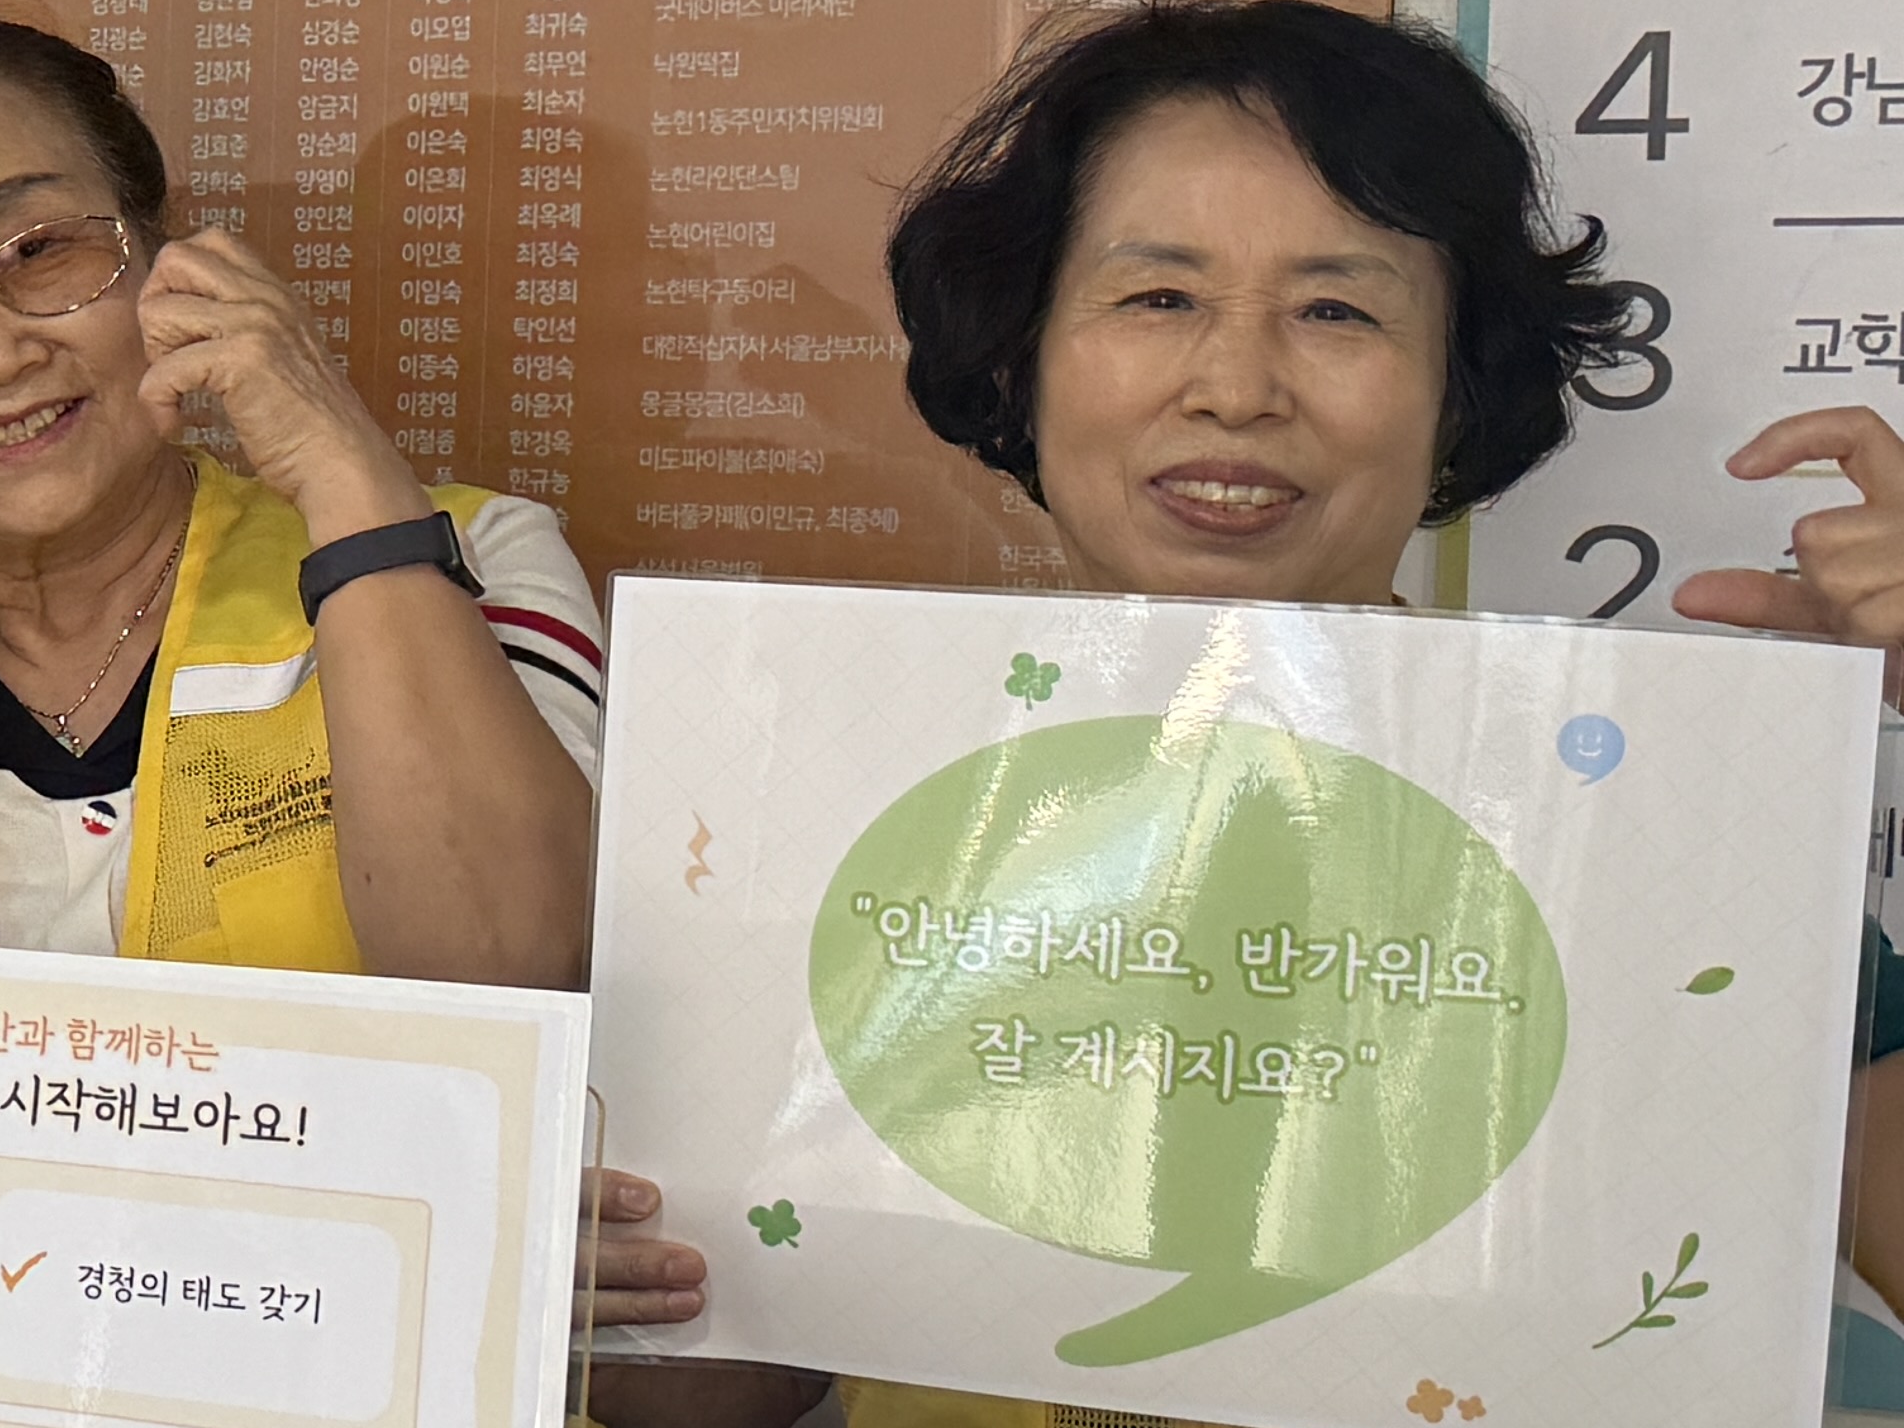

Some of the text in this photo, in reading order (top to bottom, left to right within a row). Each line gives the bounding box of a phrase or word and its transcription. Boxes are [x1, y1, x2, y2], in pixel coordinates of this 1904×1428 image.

[1575, 31, 1691, 162] 4
[647, 221, 776, 248] 논현어린이집
[855, 894, 1525, 1012] "안녕하세요, 반가워요.
[67, 1019, 219, 1072] 함께하는
[971, 1020, 1378, 1102] 잘 계시지요?"
[0, 1075, 306, 1146] 시작해보아요!
[79, 1263, 320, 1324] 경청의 태도 갖기
